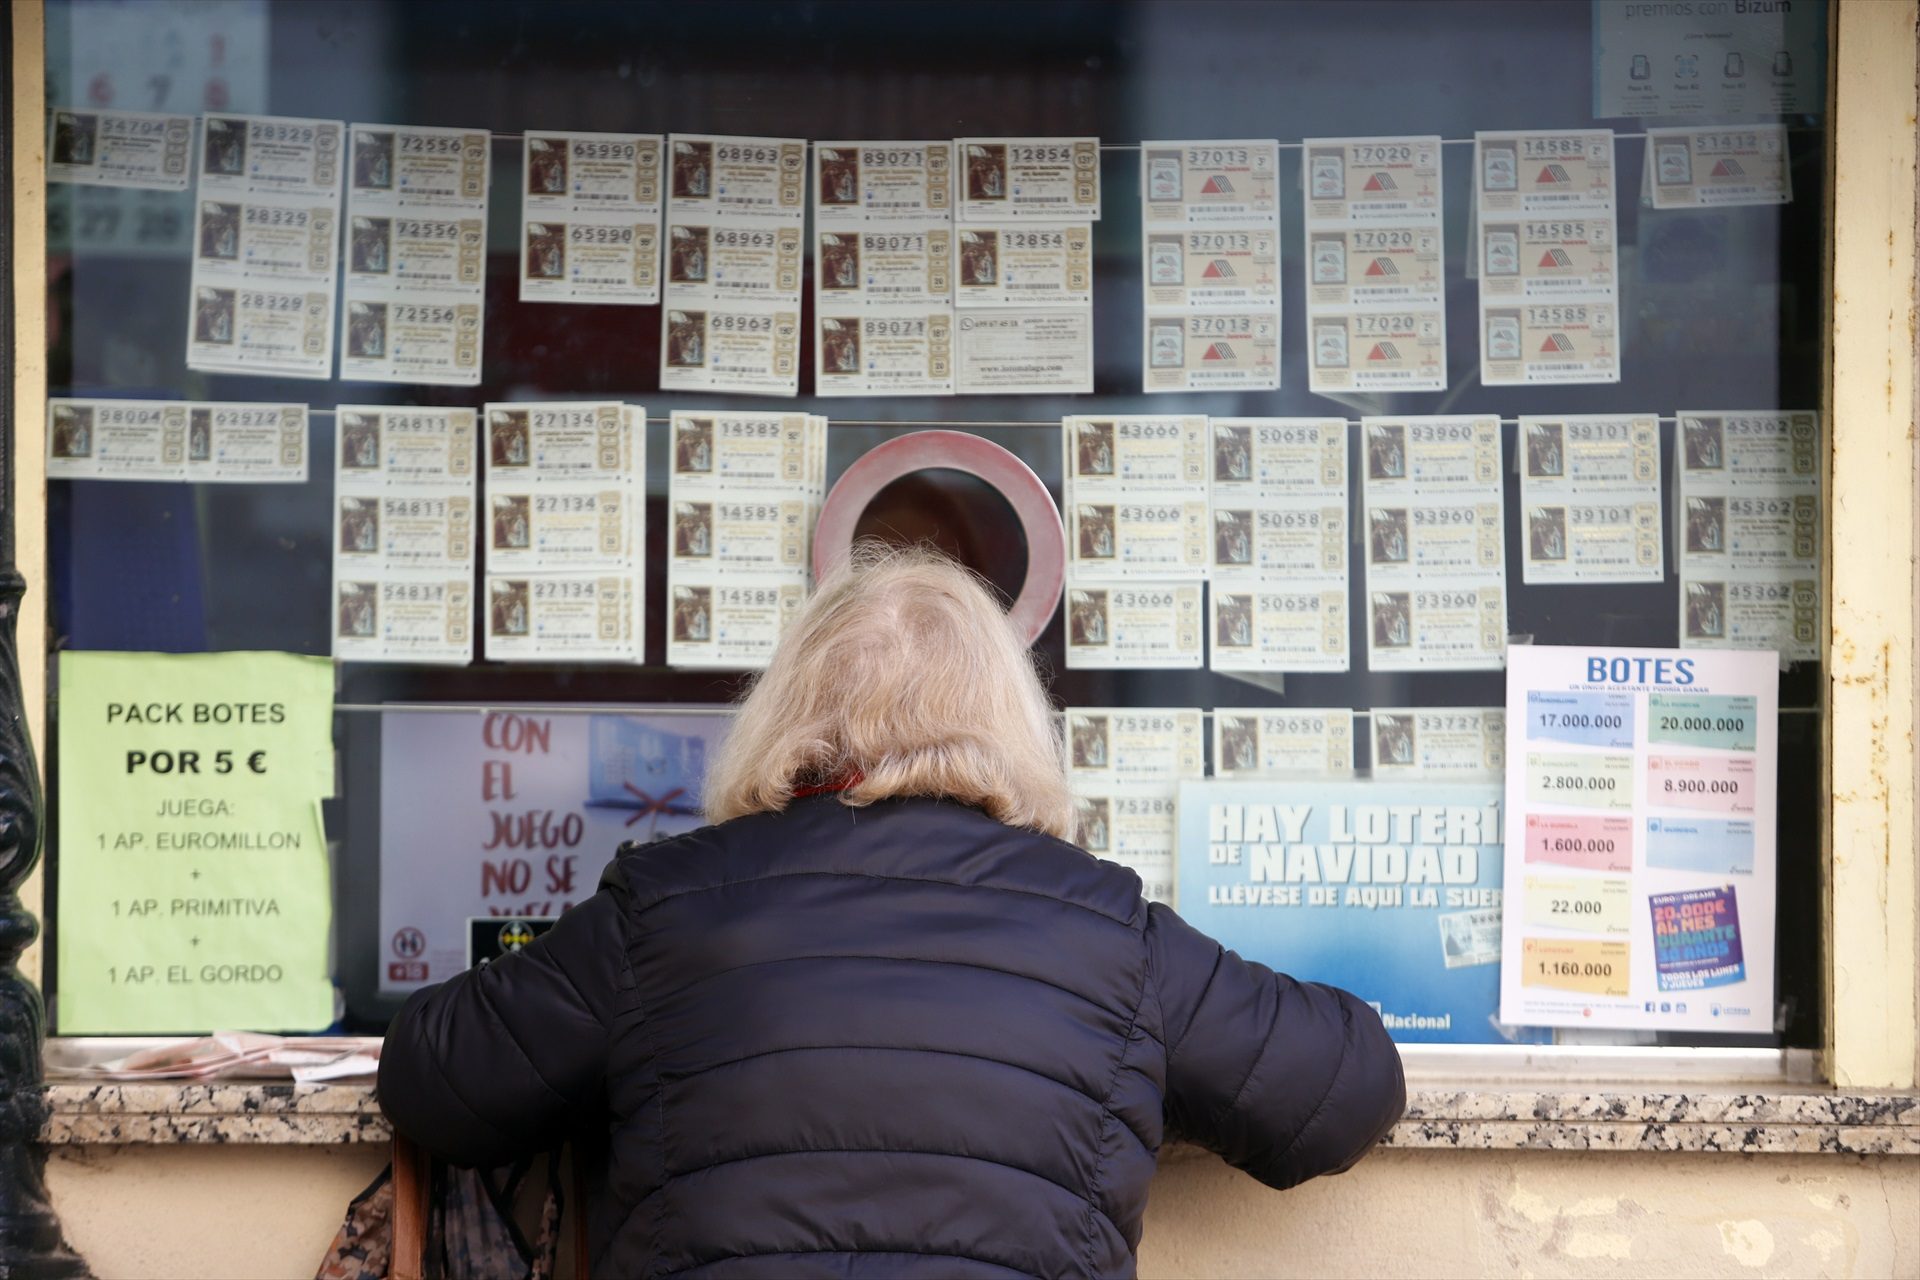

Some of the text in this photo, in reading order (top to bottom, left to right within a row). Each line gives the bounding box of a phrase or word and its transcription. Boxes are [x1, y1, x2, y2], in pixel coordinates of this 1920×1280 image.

[1626, 0, 1791, 19] premios con Bizum
[402, 137, 461, 152] 72556
[1524, 140, 1583, 152] 14585
[718, 147, 777, 162] 68963
[864, 152, 922, 165] 89071
[1012, 148, 1070, 161] 12854
[1189, 151, 1248, 163] 37013
[1353, 147, 1411, 161] 17020
[398, 222, 458, 237] 72556
[1526, 223, 1585, 235] 14585
[715, 230, 774, 246] 68963
[864, 237, 922, 250] 89071
[1005, 234, 1062, 247] 12854
[1190, 235, 1249, 248] 37013
[1354, 232, 1412, 245] 17020
[394, 307, 454, 322] 72556
[1528, 308, 1587, 321] 14585
[712, 316, 772, 331] 68963
[865, 321, 924, 335] 89071
[1190, 318, 1250, 331] 37013
[1356, 316, 1414, 330] 17020
[535, 413, 593, 427] 27134
[1728, 420, 1788, 433] 45362
[722, 423, 779, 435] 14585
[1120, 425, 1179, 437] 43666
[1260, 429, 1319, 442] 50658
[1412, 427, 1472, 440] 93960
[536, 497, 595, 510] 27134
[721, 506, 778, 518] 14585
[1121, 508, 1180, 520] 43666
[1414, 510, 1474, 523] 93960
[1572, 508, 1631, 522] 39101
[1260, 514, 1319, 527] 50658
[535, 582, 594, 596] 27134
[720, 590, 777, 602] 14585
[1114, 593, 1173, 606] 43666
[1261, 597, 1319, 610] 50658
[1417, 594, 1476, 607] 93960
[1587, 657, 1695, 685] BOTES
[107, 702, 285, 724] PACK BOTES
[1540, 713, 1622, 728] 17.000.000
[1660, 716, 1744, 732] 20.000.000
[482, 712, 551, 754] CON
[126, 750, 267, 775] POR 5 €
[481, 761, 518, 802] EL
[1542, 775, 1616, 790] 2.800.000
[1664, 779, 1739, 794] 8.900.000
[157, 799, 235, 816] JUEGA:
[482, 806, 584, 851] JUEGO
[1209, 801, 1504, 845] HAY LOTERÍ
[98, 832, 301, 850] 1 AP. EUROMILLON
[1541, 838, 1615, 853] 1.600.000
[1209, 844, 1480, 885] DE NAVIDAD
[481, 855, 580, 898] NO SE
[1209, 882, 1302, 907] LLÉVESE
[1308, 887, 1339, 907] DE
[1345, 885, 1404, 910] AQUÍ
[1410, 888, 1441, 907] LA
[112, 900, 281, 917] 1 AP. PRIMITIVA
[1551, 900, 1602, 914] 22.000
[108, 965, 284, 983] 1 AP. EL GORDO
[1538, 962, 1612, 976] 1.160.000
[1382, 1013, 1451, 1029] Nacional
